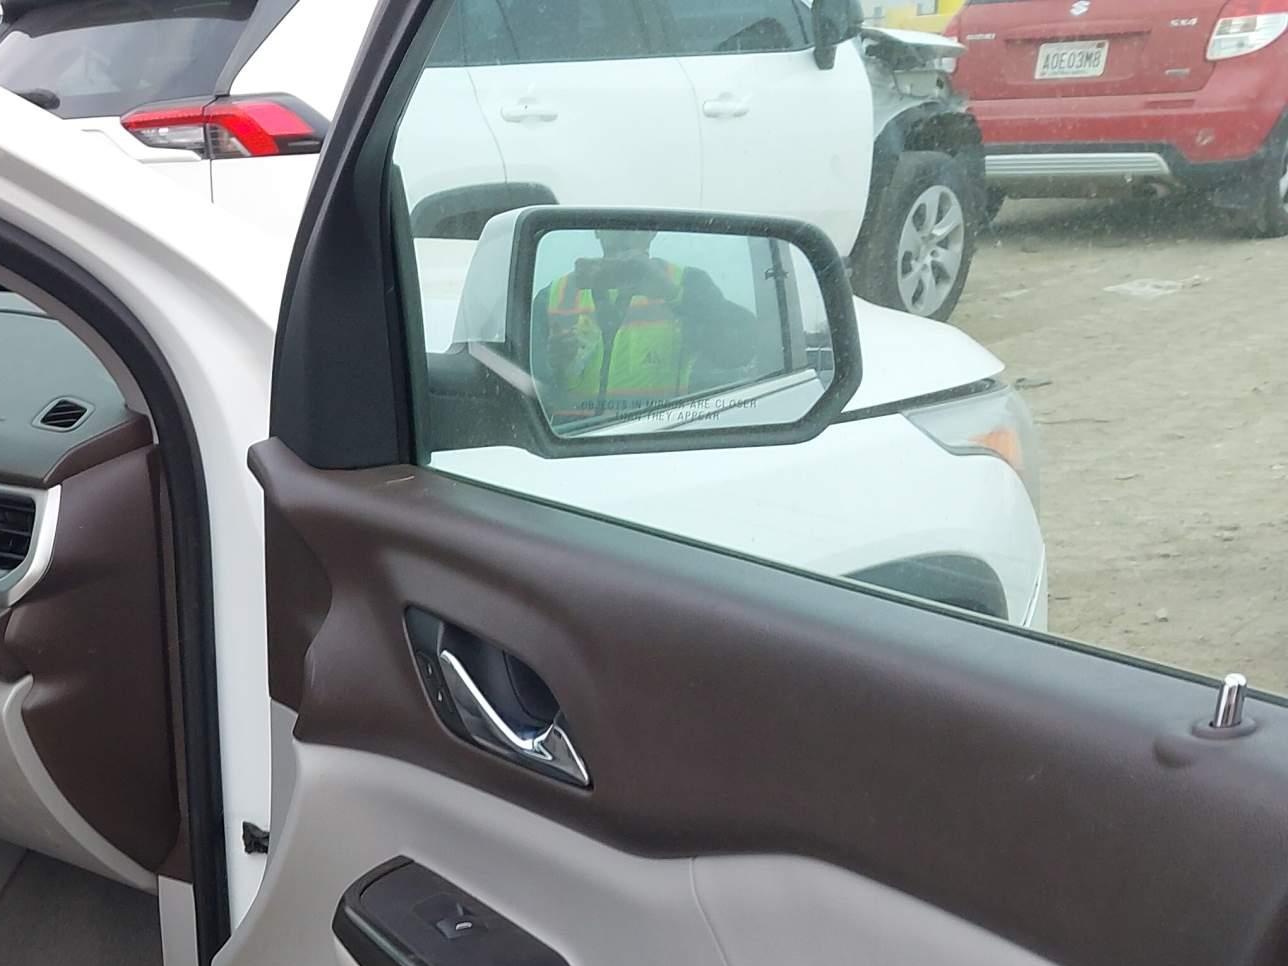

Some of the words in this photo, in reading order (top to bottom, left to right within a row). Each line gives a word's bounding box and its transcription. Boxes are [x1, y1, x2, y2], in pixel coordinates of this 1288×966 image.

[689, 399, 710, 409] ARE
[715, 399, 757, 409] CLOSER
[647, 411, 672, 421] THEY
[677, 411, 720, 421] APPEAR
